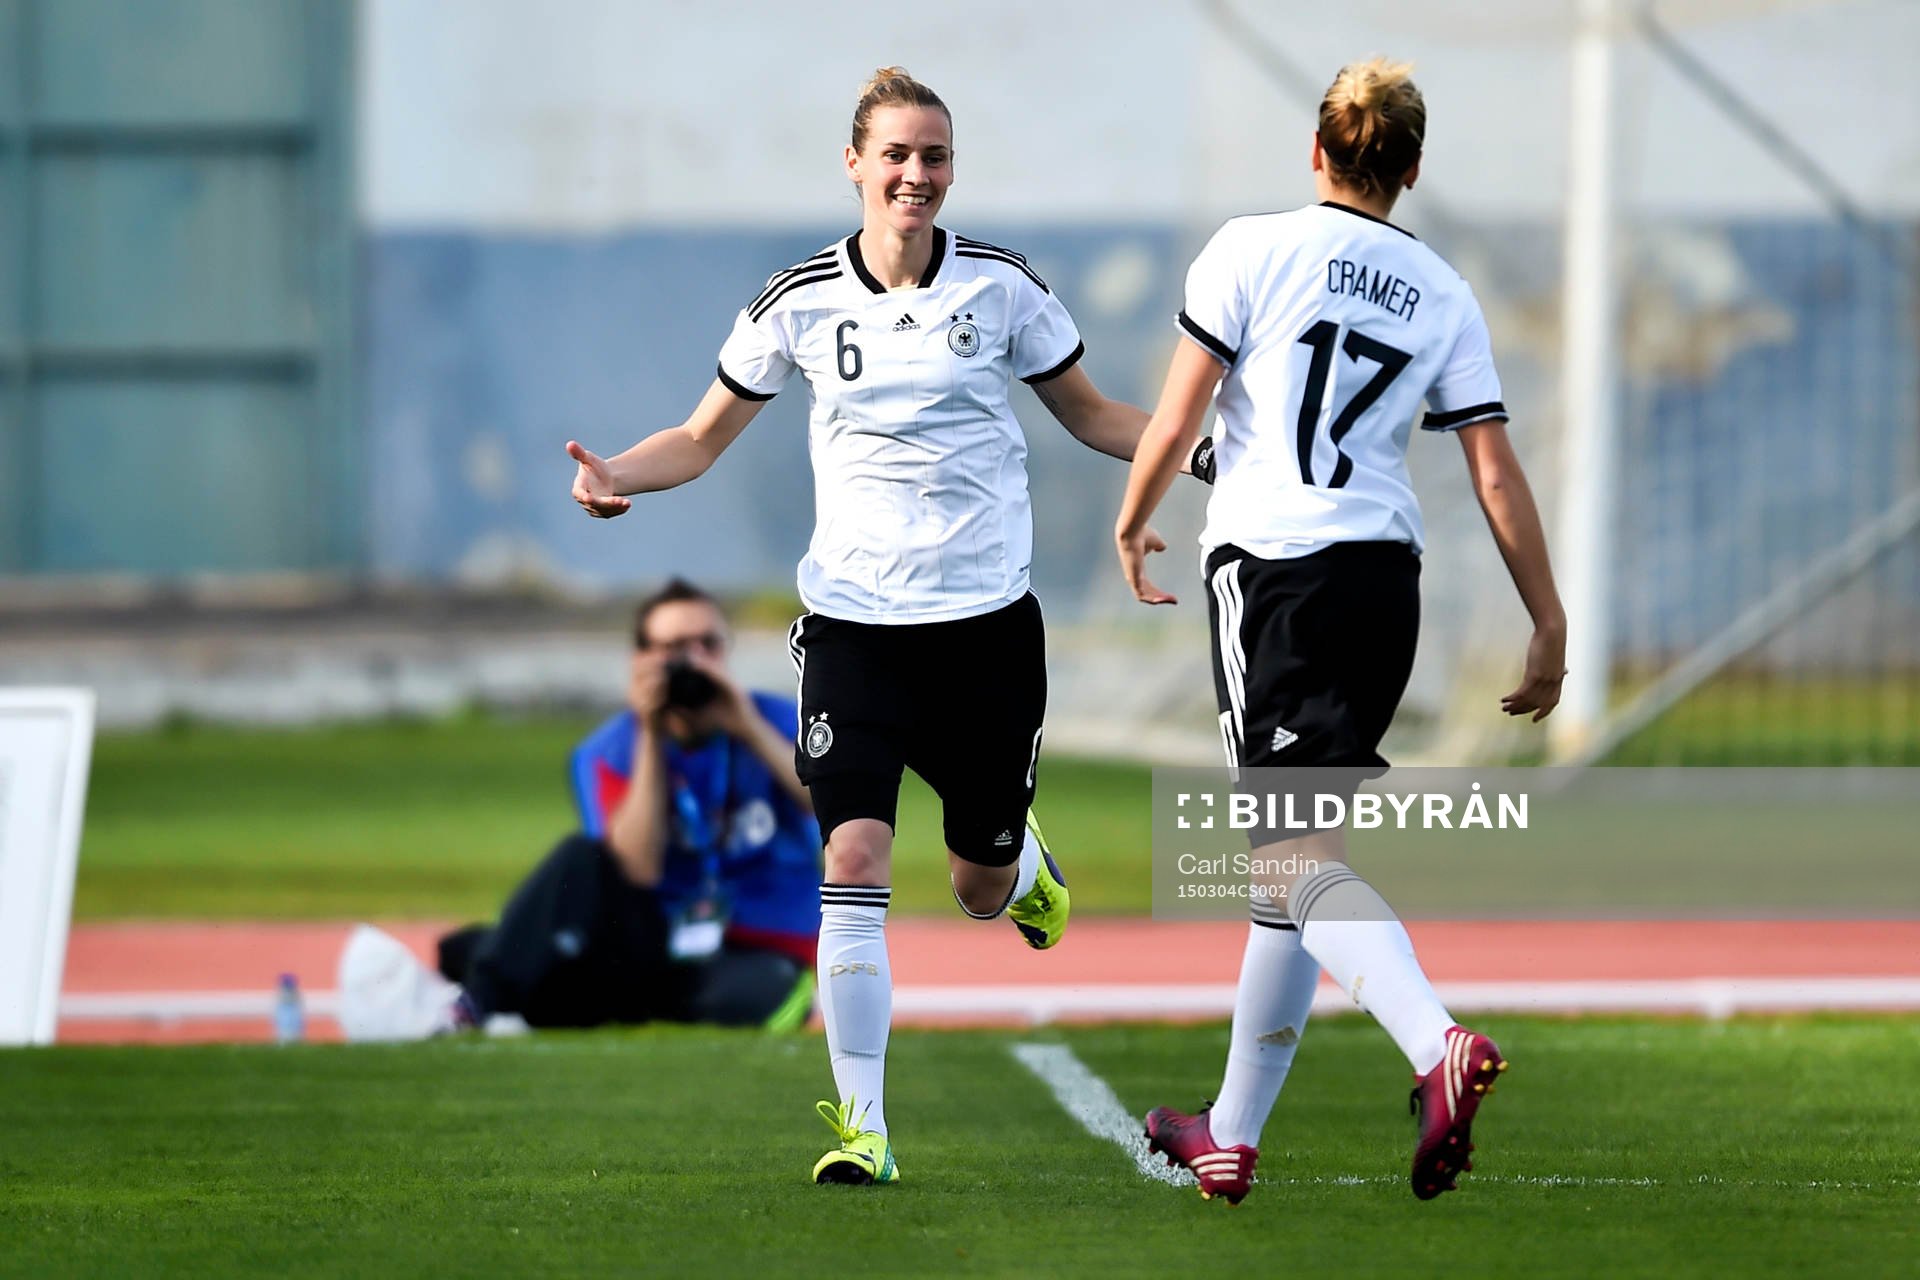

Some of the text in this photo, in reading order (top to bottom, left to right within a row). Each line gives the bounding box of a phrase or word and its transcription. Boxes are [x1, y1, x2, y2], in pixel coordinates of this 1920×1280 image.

[1327, 258, 1420, 322] CRAMER
[836, 319, 863, 382] 6
[892, 323, 921, 333] adidas
[1296, 318, 1414, 489] 17
